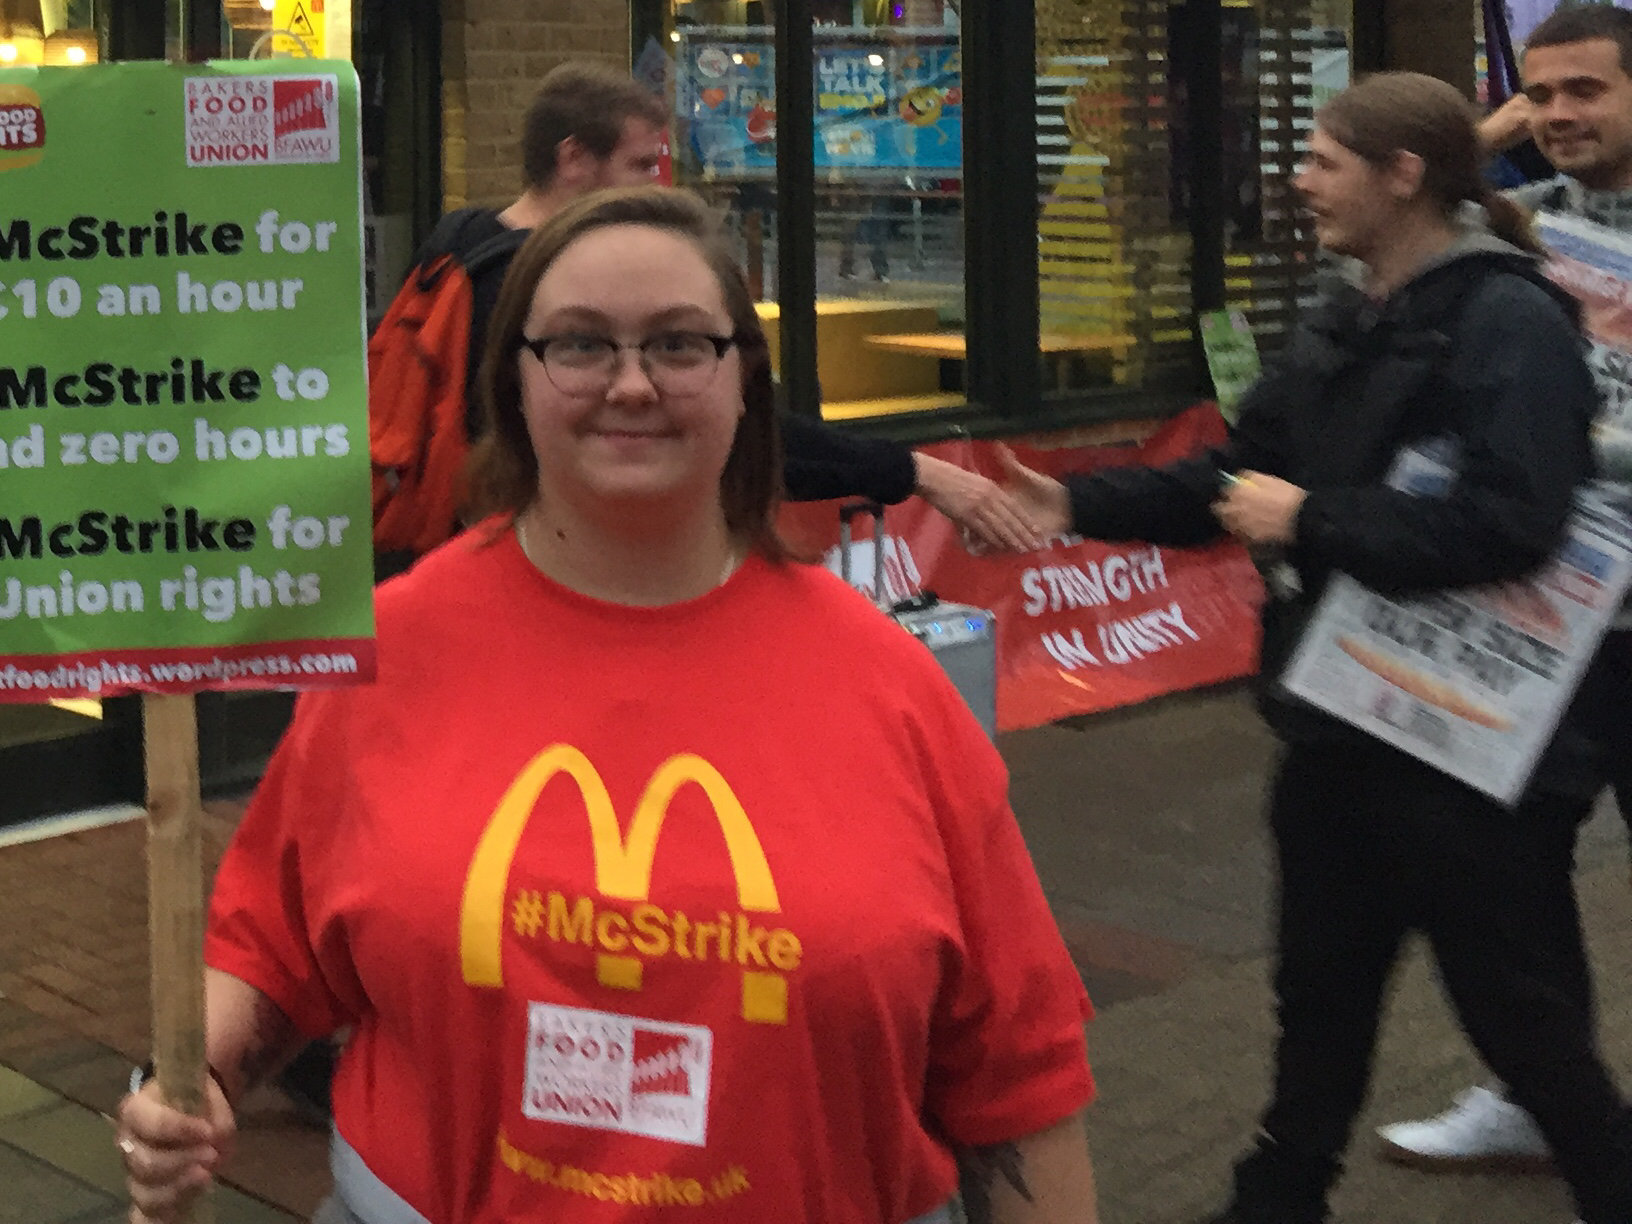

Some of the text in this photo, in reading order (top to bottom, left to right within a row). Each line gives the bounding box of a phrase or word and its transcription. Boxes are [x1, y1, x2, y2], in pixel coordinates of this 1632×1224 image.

[187, 79, 268, 95] BAKERS
[188, 95, 268, 115] FOOD
[189, 127, 268, 143] WORKERS
[189, 143, 268, 163] UNION
[254, 208, 338, 253] for
[96, 281, 161, 317] an
[175, 270, 304, 314] hour
[270, 362, 330, 402] to
[59, 428, 181, 467] zero
[193, 417, 351, 462] hours
[266, 504, 351, 550] for
[159, 564, 322, 623] rights
[1040, 600, 1201, 671] IN UNITY
[511, 887, 804, 971] #McStrike
